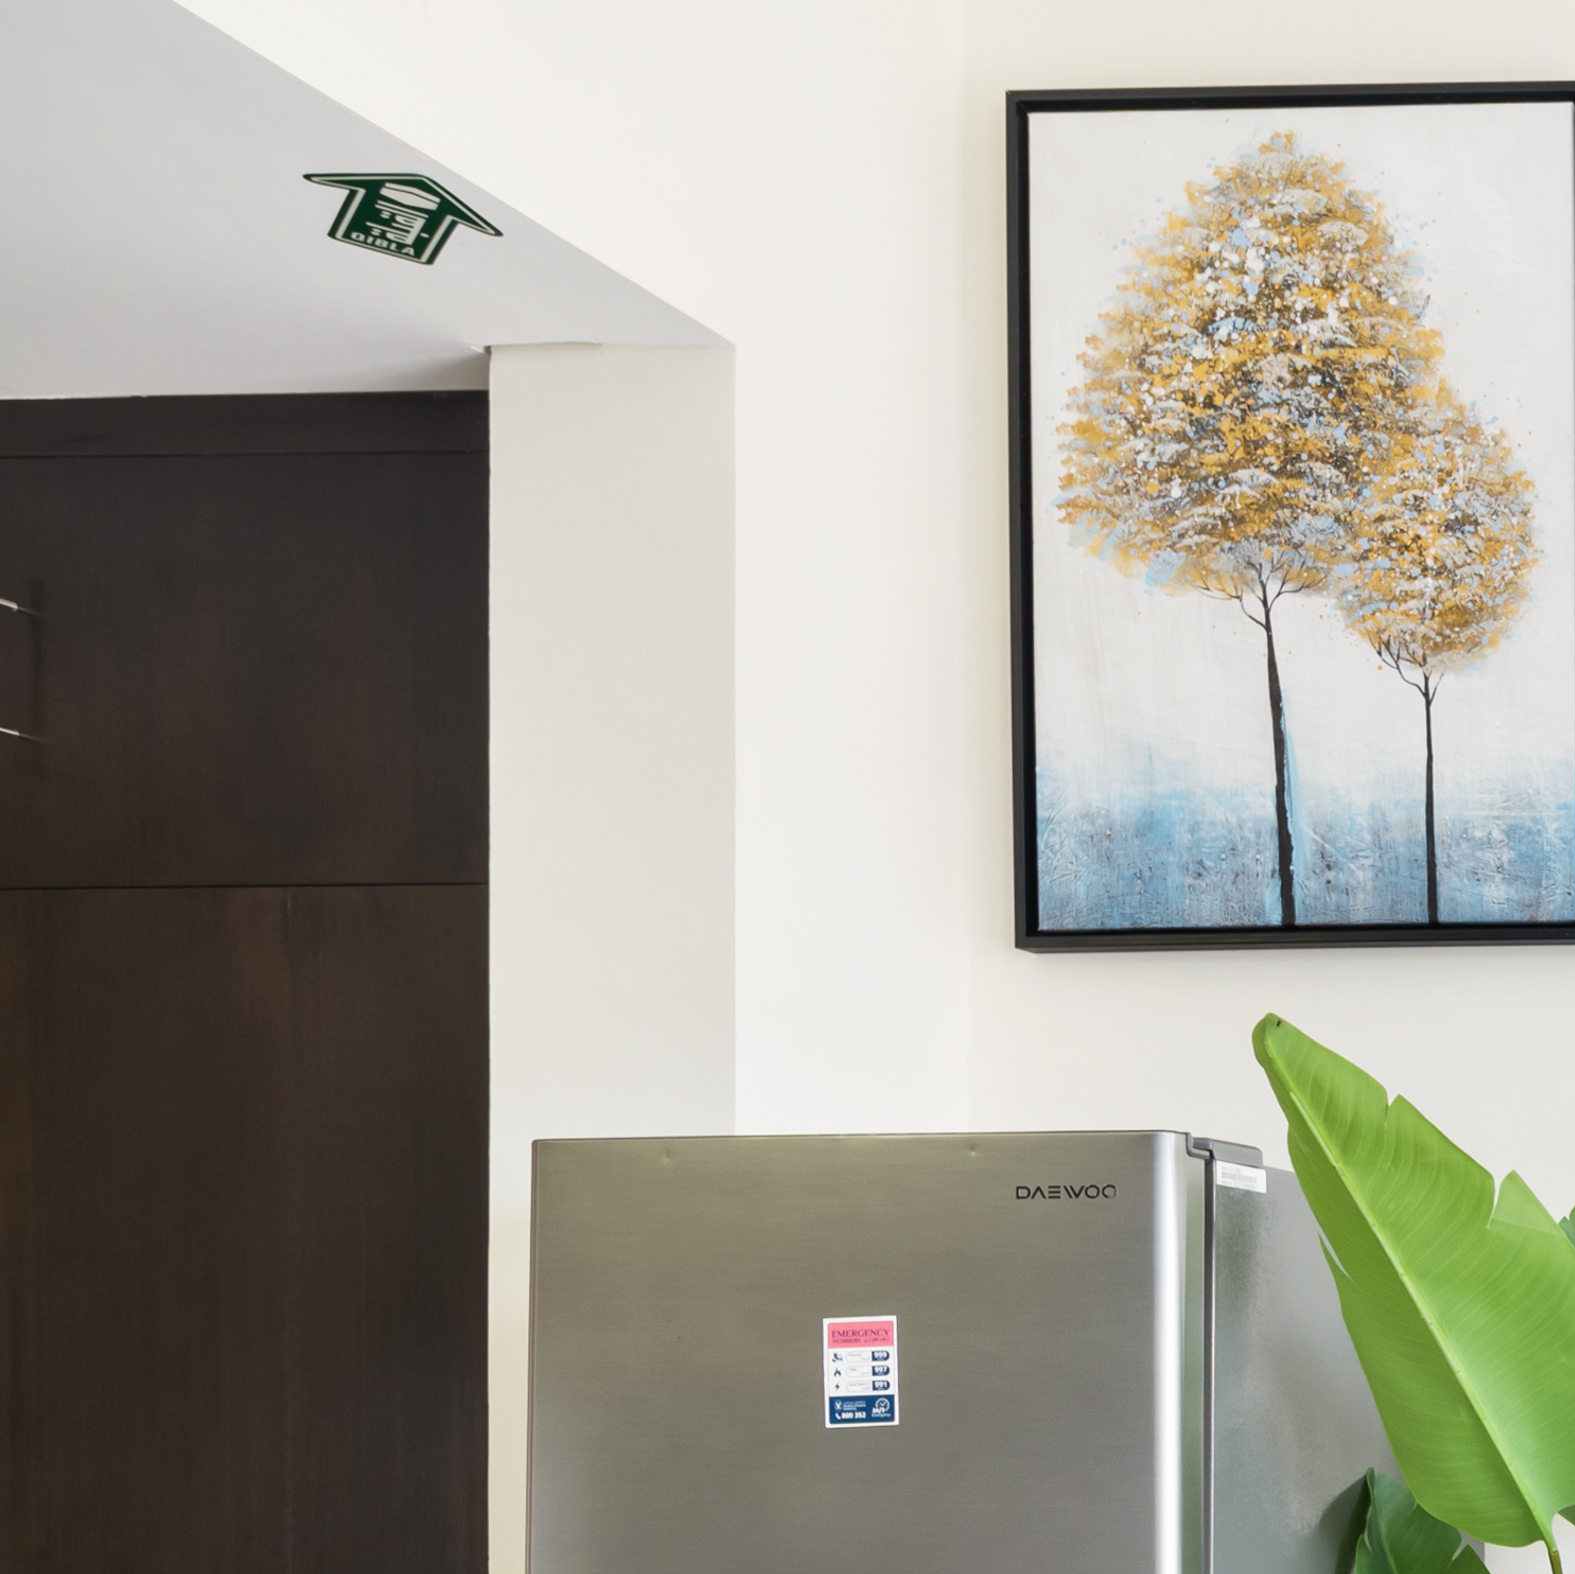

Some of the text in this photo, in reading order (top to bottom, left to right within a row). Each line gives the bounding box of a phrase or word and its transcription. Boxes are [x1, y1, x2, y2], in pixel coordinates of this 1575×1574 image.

[350, 231, 415, 256] QIBLA
[1015, 1184, 1117, 1199] DAEWOO
[832, 1329, 890, 1338] EMERGENCY
